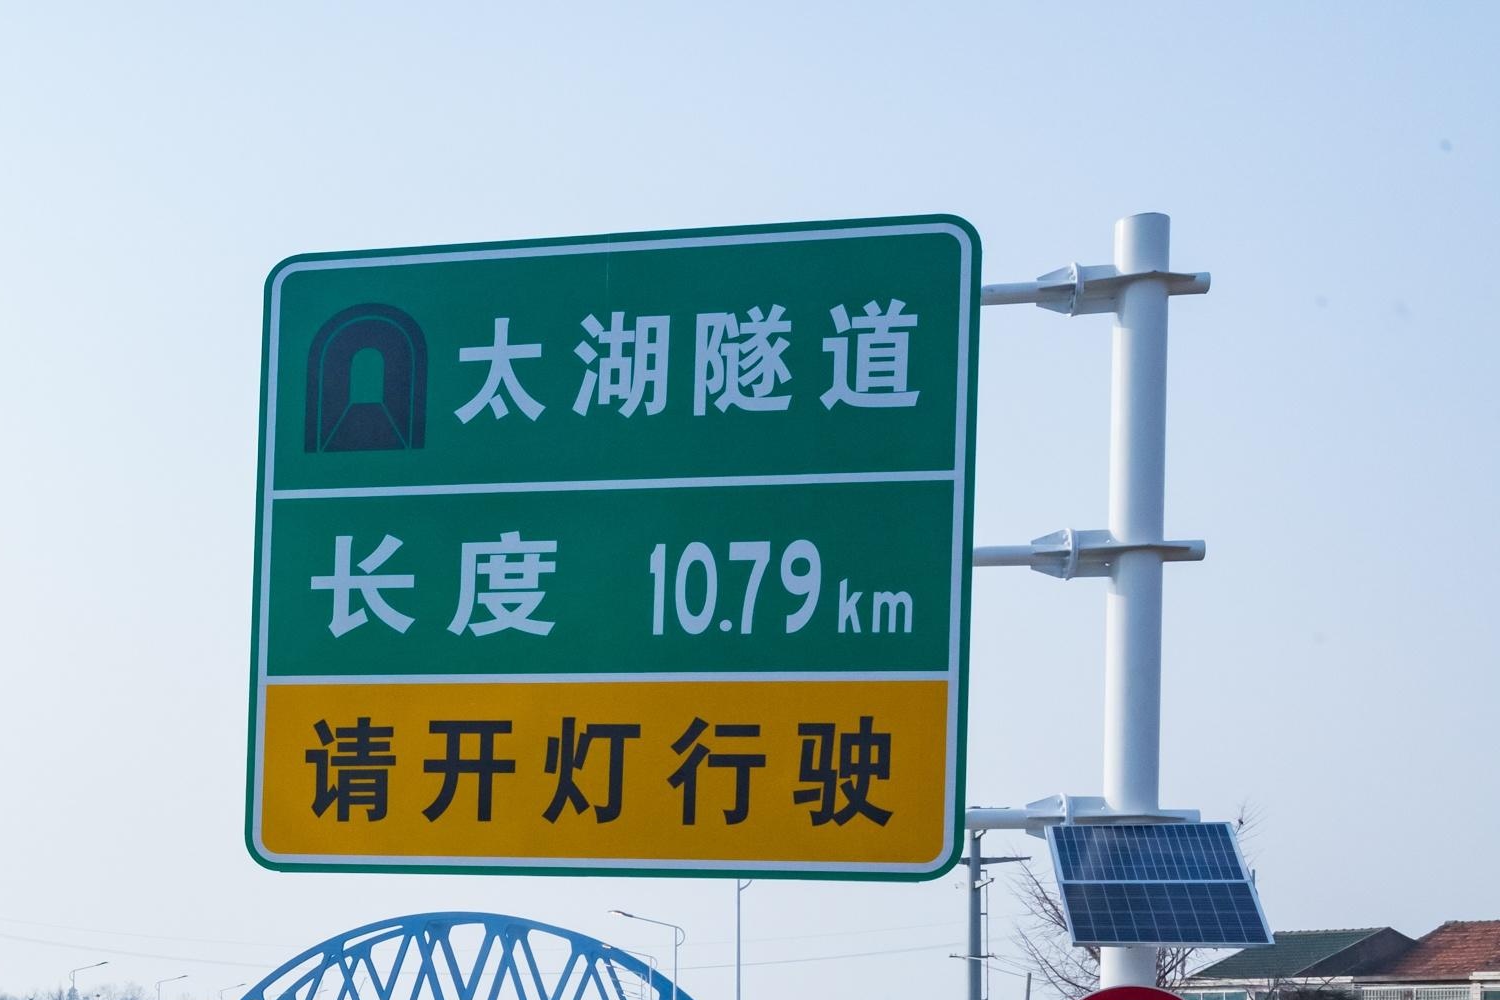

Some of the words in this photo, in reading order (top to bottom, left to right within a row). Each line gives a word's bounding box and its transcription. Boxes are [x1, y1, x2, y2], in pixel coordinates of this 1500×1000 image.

[454, 299, 920, 423] 太湖隧道
[310, 531, 558, 638] 长度
[305, 715, 894, 827] 请开灯行驶
